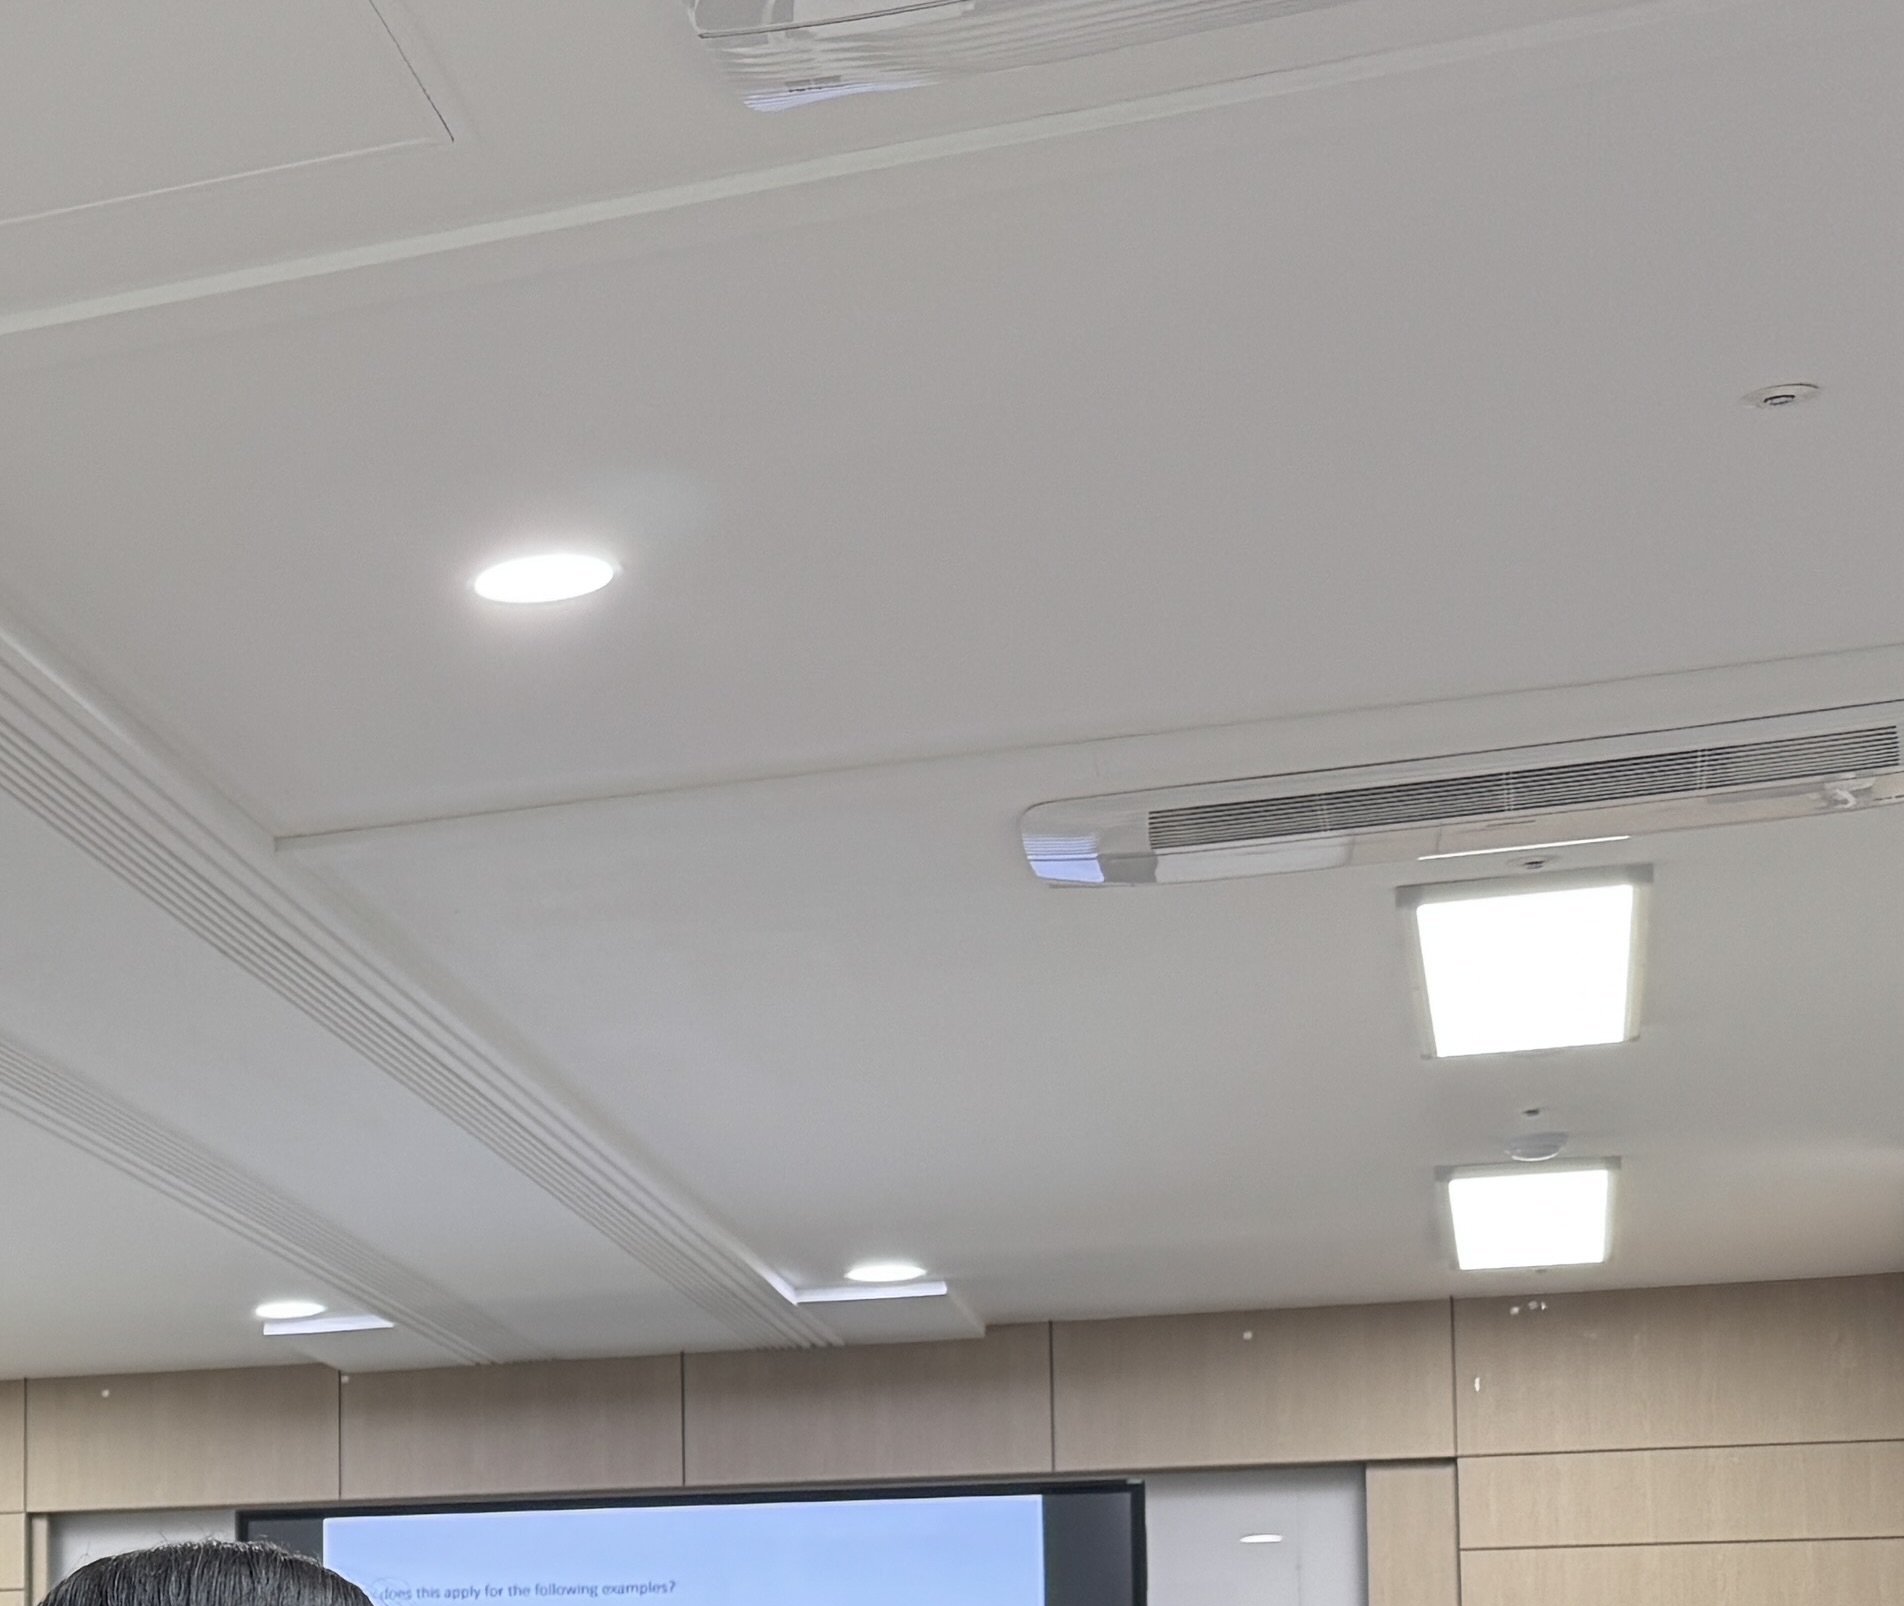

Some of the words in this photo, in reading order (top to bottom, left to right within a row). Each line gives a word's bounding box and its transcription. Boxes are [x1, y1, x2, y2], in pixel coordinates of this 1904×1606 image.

[416, 1586, 441, 1600] this
[444, 1586, 480, 1601] apply
[485, 1584, 503, 1598] for
[508, 1584, 531, 1597] the
[535, 1582, 599, 1598] following
[602, 1580, 677, 1597] examples?
